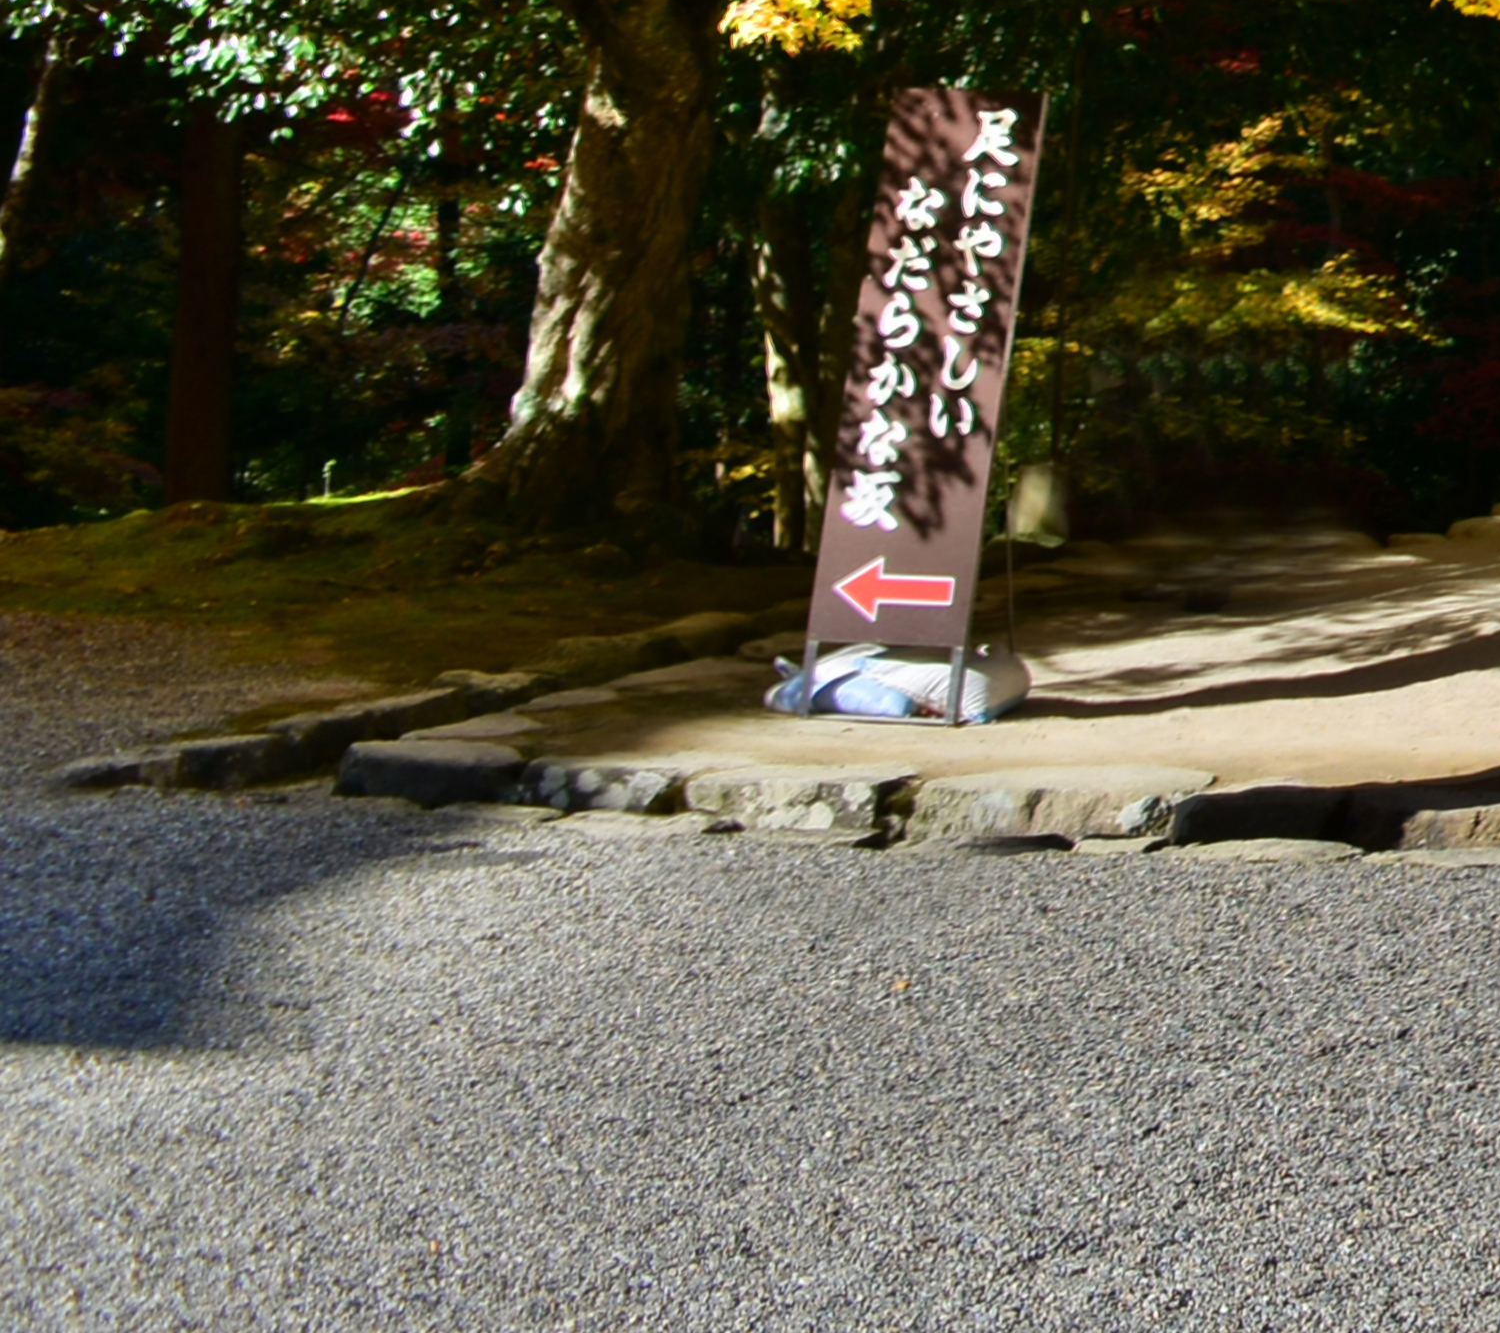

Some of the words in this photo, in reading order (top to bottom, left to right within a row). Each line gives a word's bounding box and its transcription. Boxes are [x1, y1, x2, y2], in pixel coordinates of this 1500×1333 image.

[840, 176, 945, 532] なだらかな坂
[930, 107, 1019, 438] 足にやさしい
